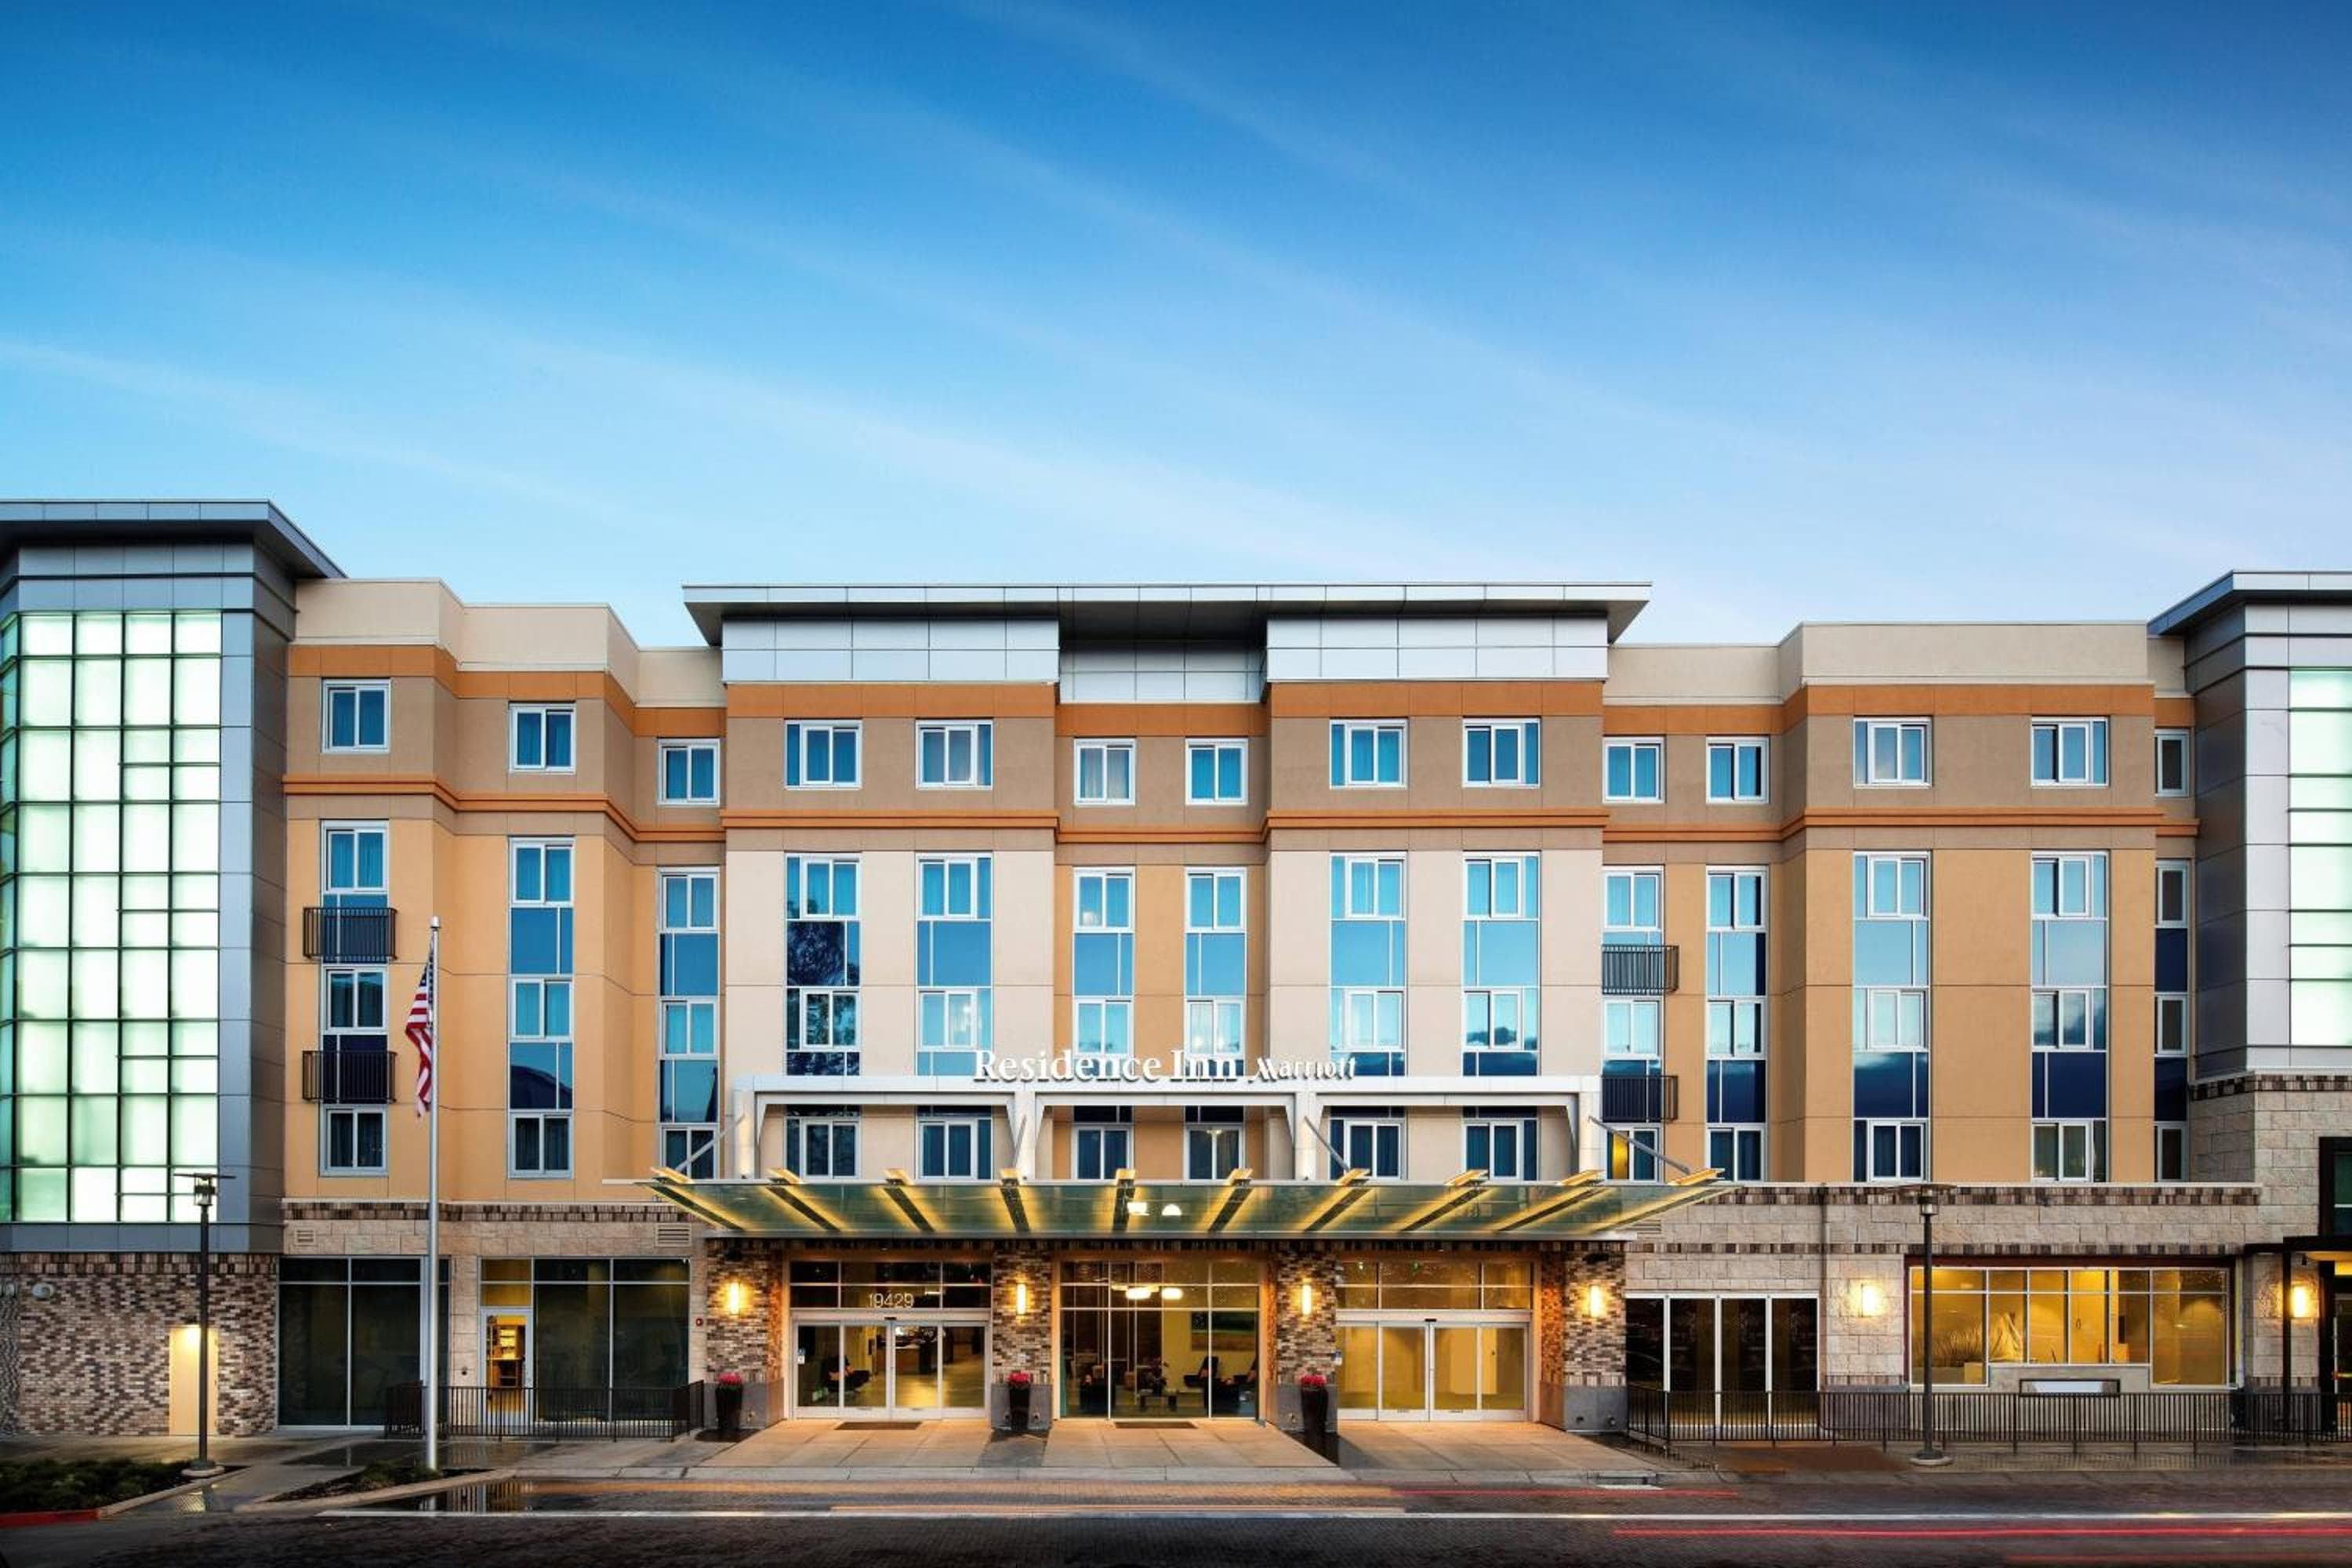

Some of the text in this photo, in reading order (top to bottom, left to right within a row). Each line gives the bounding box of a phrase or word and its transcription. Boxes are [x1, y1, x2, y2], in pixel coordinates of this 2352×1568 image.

[974, 1049, 1356, 1081] Residence Inn Marriott
[869, 1293, 914, 1308] 19429
